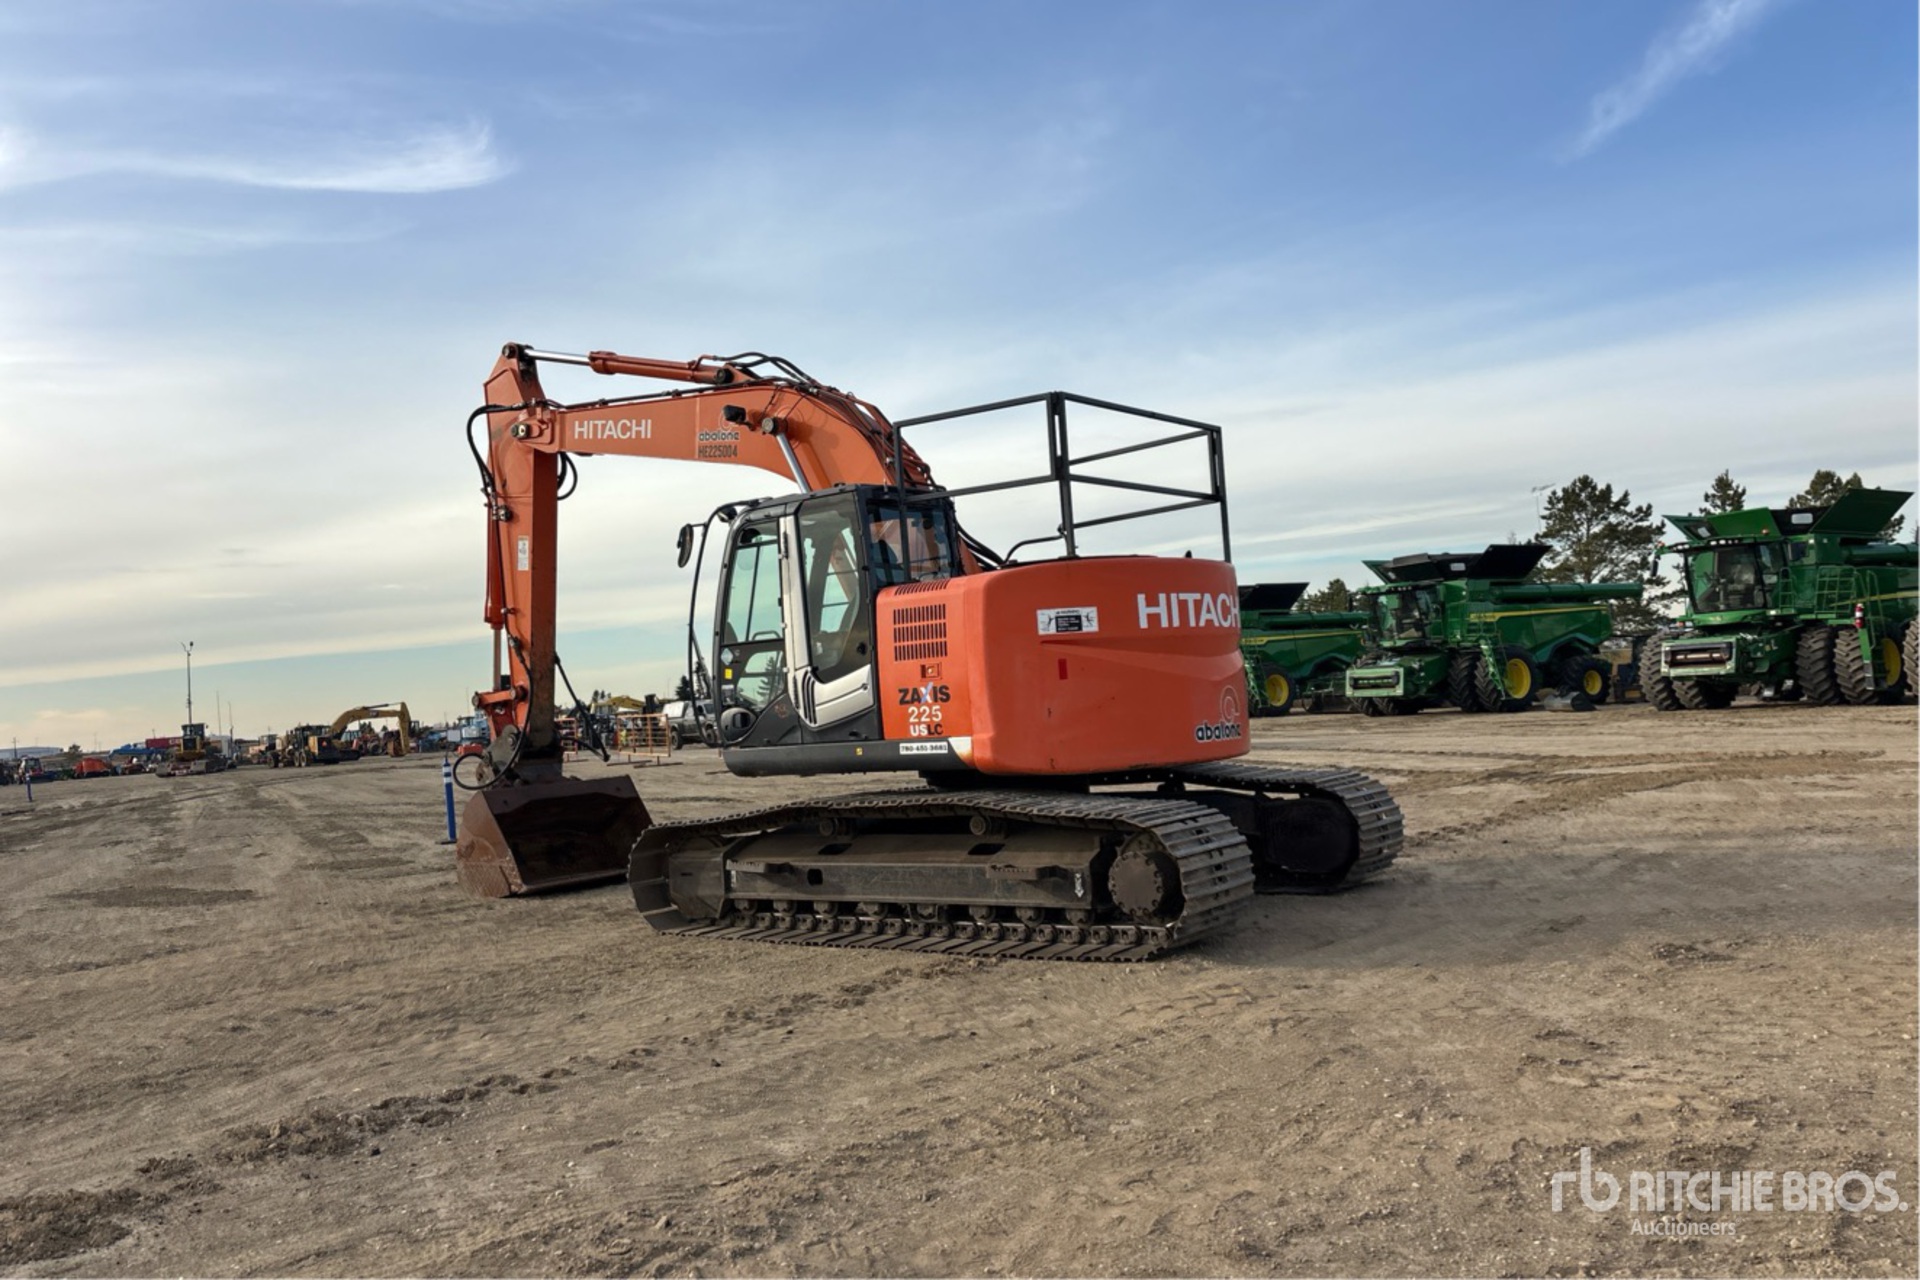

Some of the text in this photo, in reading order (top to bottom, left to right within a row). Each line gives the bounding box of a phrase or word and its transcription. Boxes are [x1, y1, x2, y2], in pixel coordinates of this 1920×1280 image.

[574, 419, 652, 439] HITACHI
[698, 445, 738, 458] HE225004
[898, 682, 951, 705] ZAXIS
[908, 705, 942, 722] 225
[910, 724, 944, 737] USLC
